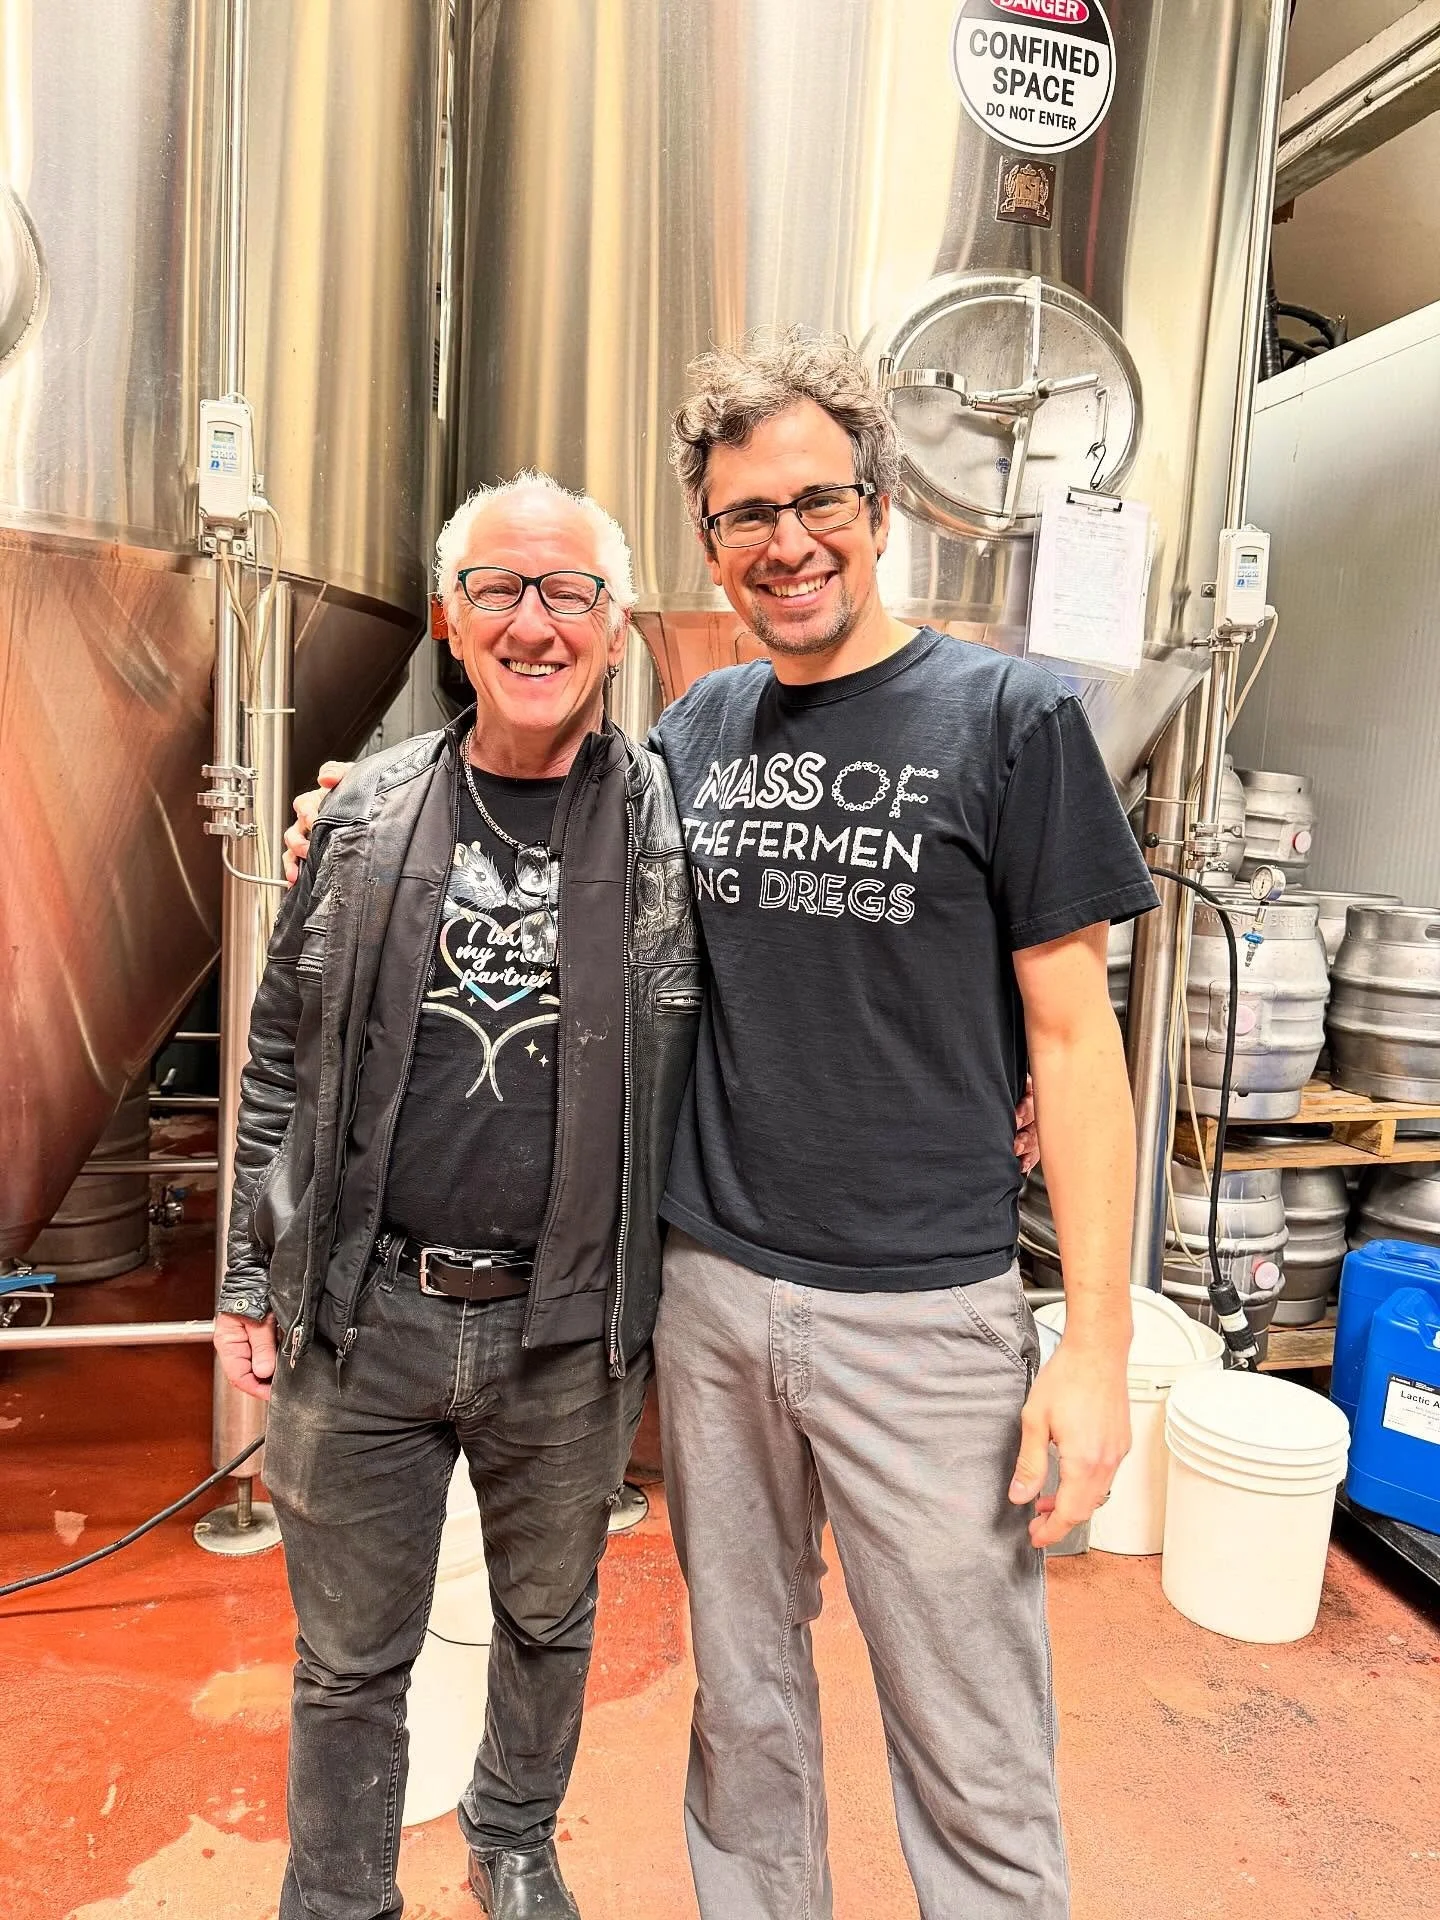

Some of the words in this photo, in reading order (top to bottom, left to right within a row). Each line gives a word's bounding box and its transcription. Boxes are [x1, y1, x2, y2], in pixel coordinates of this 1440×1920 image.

[969, 28, 1100, 78] CONFINED
[992, 66, 1075, 107] SPACE
[985, 102, 1005, 117] DO
[1009, 105, 1036, 124] NOT
[1038, 110, 1077, 131] ENTER
[692, 751, 827, 811] MASS
[831, 760, 940, 818] OF
[682, 817, 736, 857] THE
[735, 820, 922, 873] FERMEN
[758, 868, 916, 925] DREGS
[467, 920, 482, 944] I
[486, 922, 536, 947] love
[455, 944, 496, 972] my
[459, 966, 553, 990] partner
[1400, 1389, 1430, 1406] Lactic
